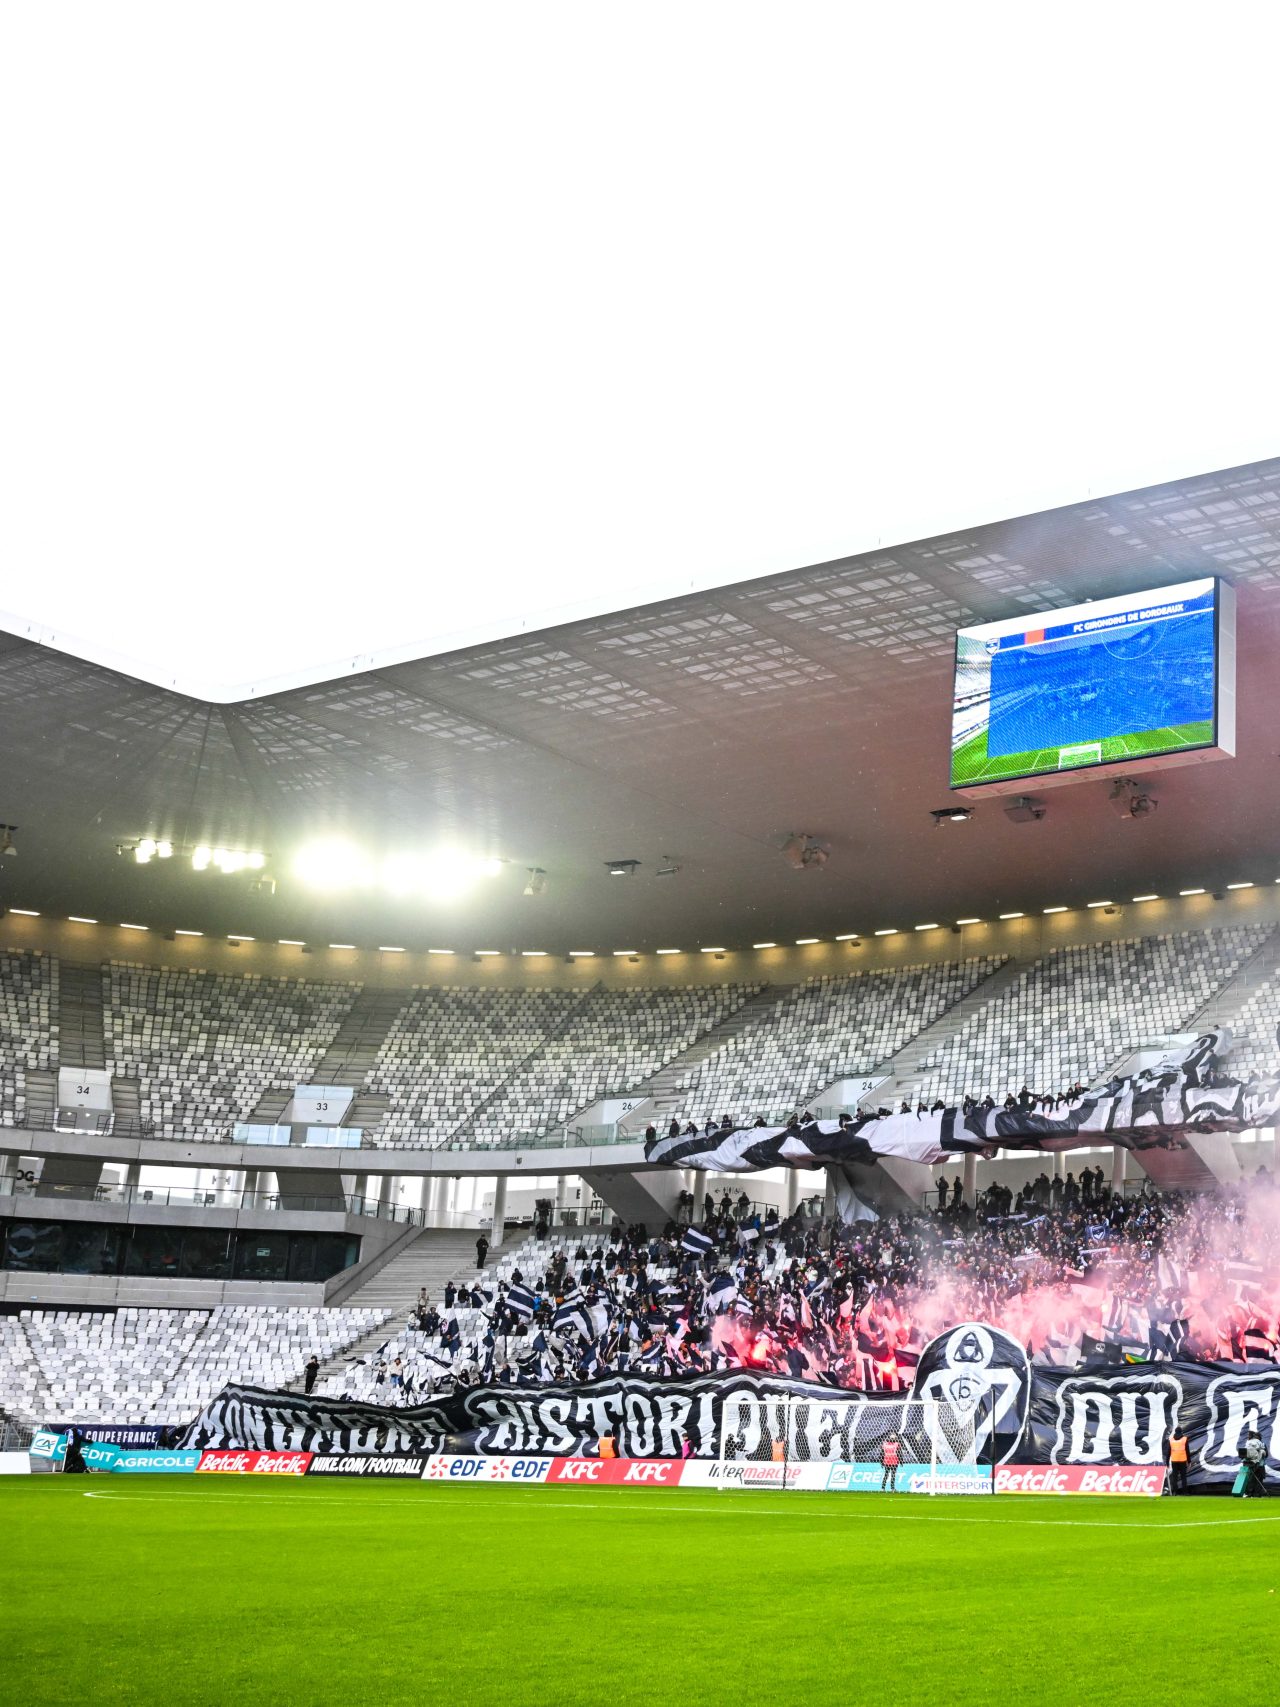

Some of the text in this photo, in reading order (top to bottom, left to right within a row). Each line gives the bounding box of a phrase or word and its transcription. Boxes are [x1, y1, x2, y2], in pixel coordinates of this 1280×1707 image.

[1073, 603, 1184, 632] FC GIRONDINS DE BORDEAUX
[76, 1085, 90, 1095] 34
[862, 1081, 873, 1091] 24
[316, 1102, 329, 1111] 33
[622, 1102, 633, 1111] 26
[1068, 1390, 1168, 1464] DU
[86, 1431, 116, 1443] COUPE
[123, 1431, 157, 1443] FRANCE
[57, 1443, 196, 1467] CÉDIT AGRICOLE
[200, 1453, 306, 1473] Betclic Betclic
[310, 1456, 422, 1475] NIKE.COM/FOOTBALL
[558, 1461, 603, 1480] KFC
[624, 1463, 672, 1481] KFC
[852, 1468, 907, 1484] CRÉT
[995, 1468, 1158, 1493] Betclic Betclic
